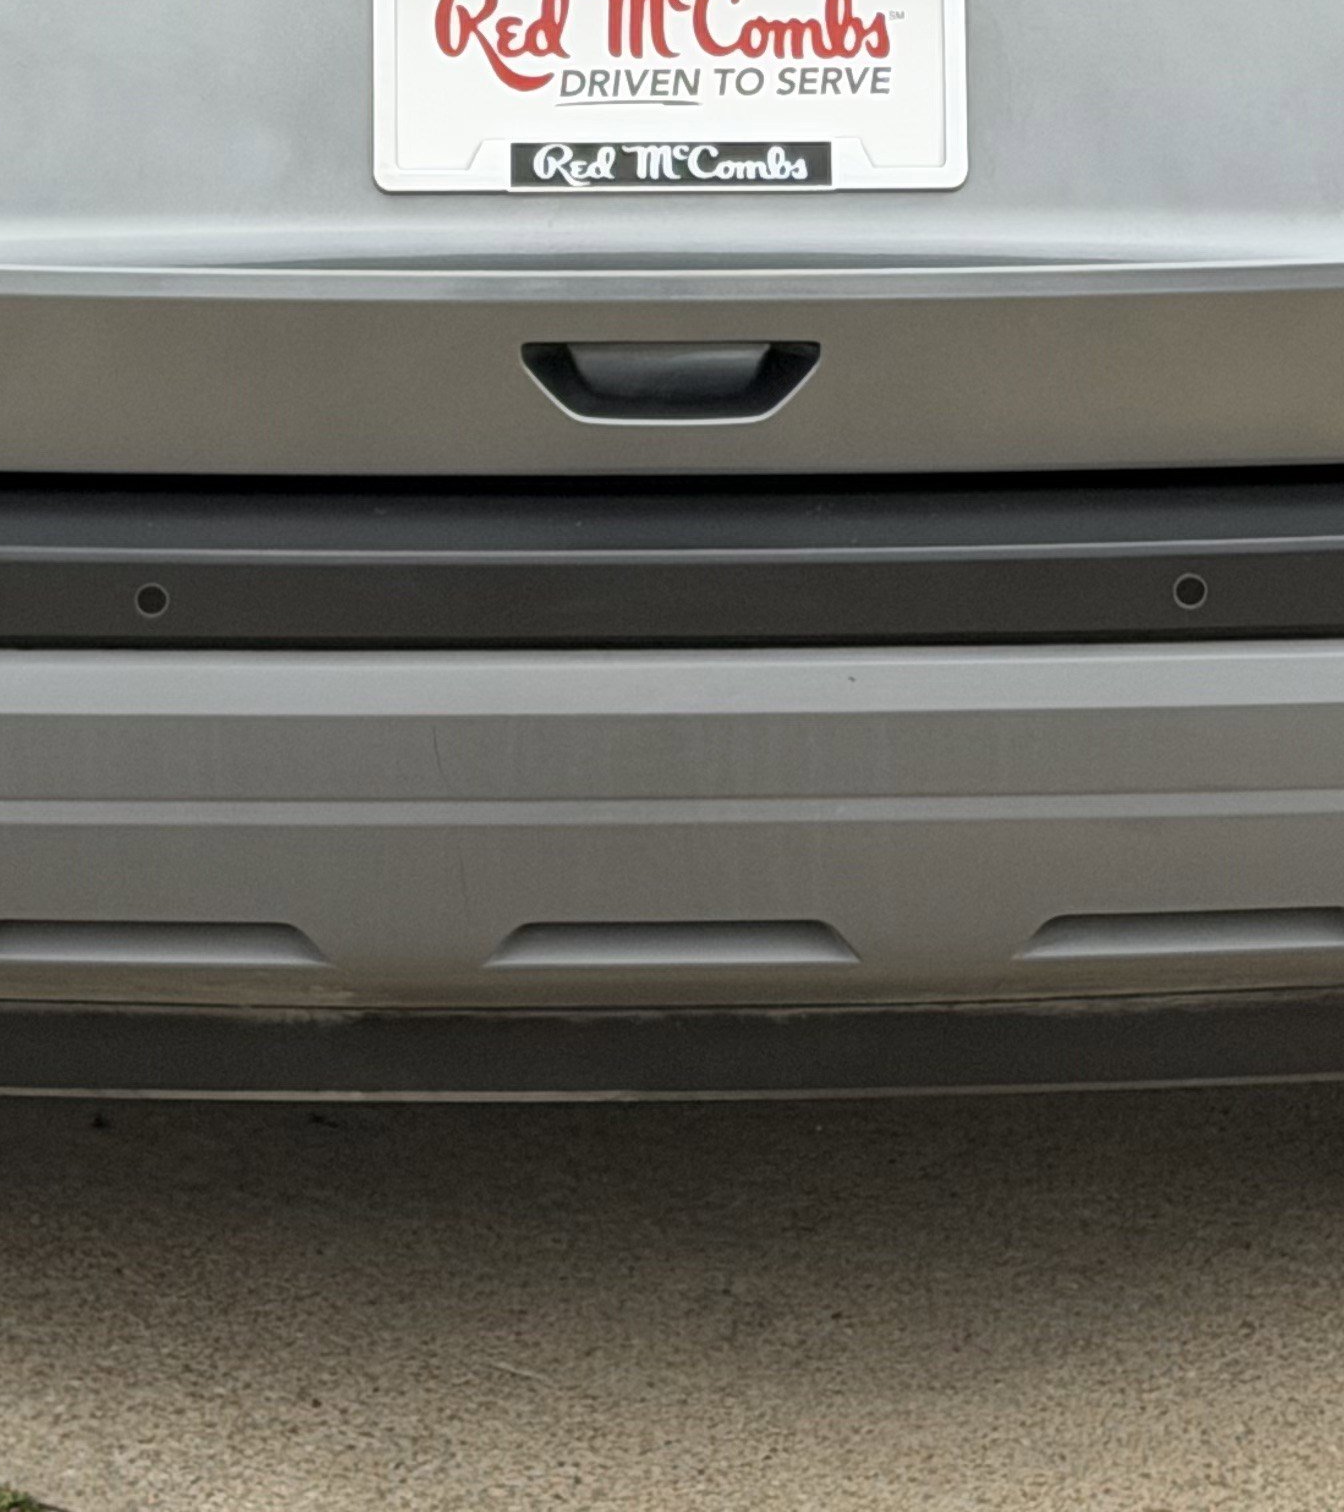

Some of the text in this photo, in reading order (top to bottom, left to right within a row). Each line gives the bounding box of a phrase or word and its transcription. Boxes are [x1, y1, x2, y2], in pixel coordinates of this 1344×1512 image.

[559, 66, 893, 97] DRIVEN TO SERVE
[533, 143, 809, 186] Red McCombs
